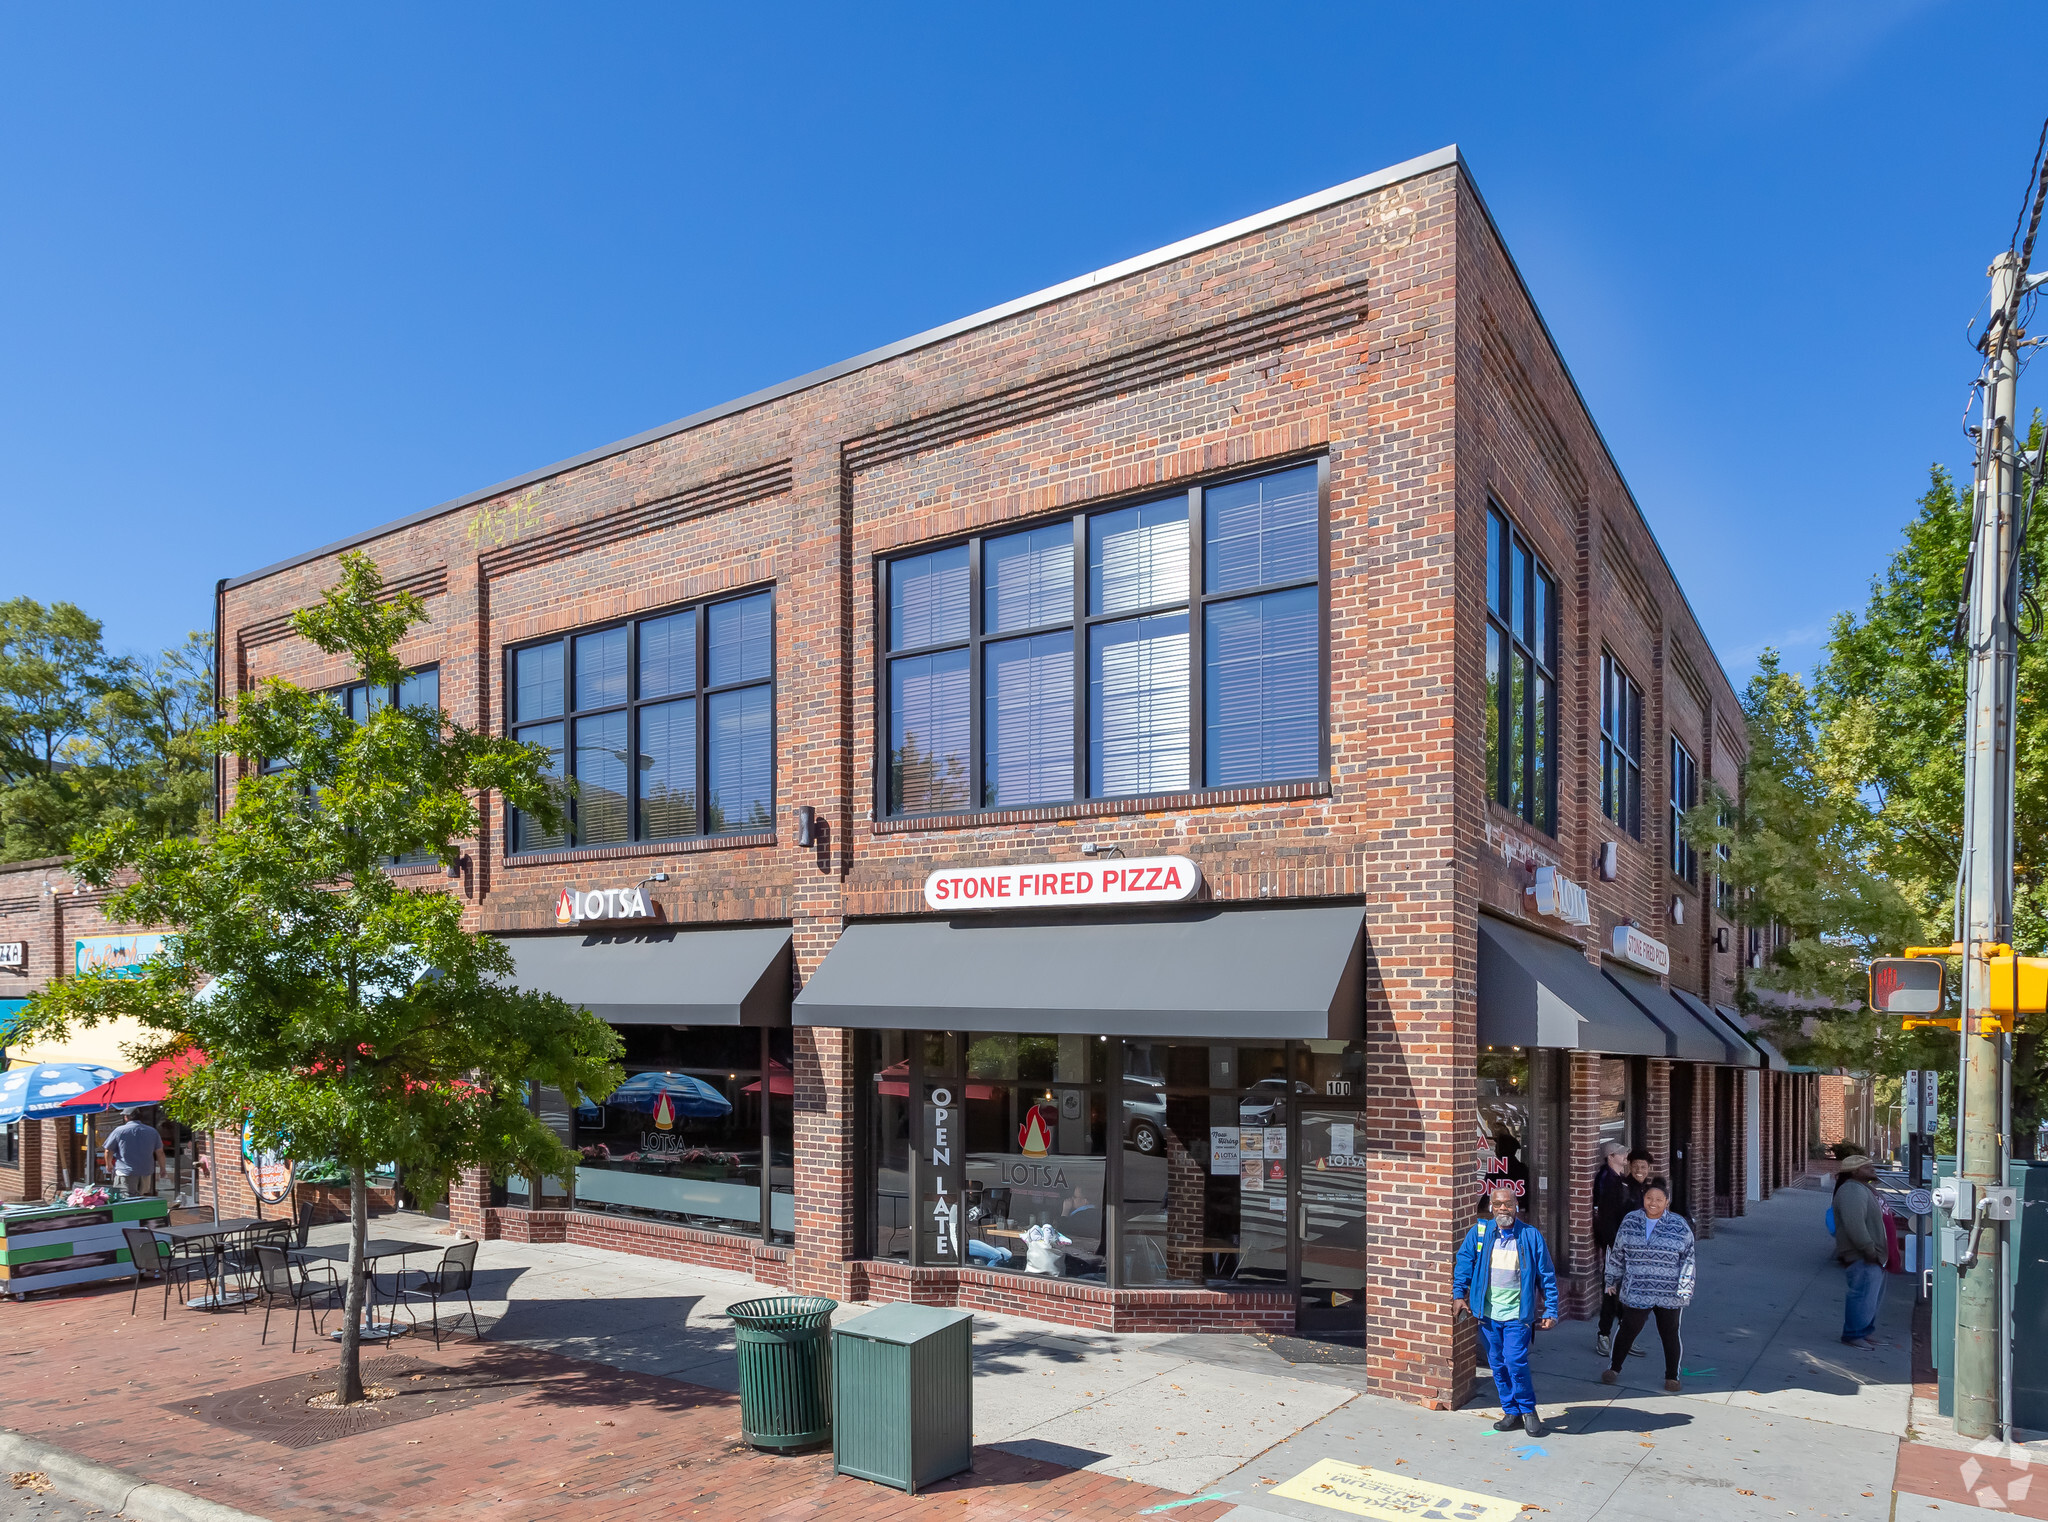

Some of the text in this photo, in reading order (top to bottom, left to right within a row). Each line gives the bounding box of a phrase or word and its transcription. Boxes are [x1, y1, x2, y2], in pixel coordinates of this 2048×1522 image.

[935, 866, 1182, 900] STONE FIRED PIZZA
[574, 887, 647, 920] LOTSA
[1628, 934, 1667, 966] STONE FIRED PIZZA
[1328, 1081, 1350, 1096] 100
[931, 1088, 952, 1166] OPEN
[1211, 1131, 1227, 1139] Now
[640, 1131, 687, 1155] LOTSA
[1218, 1138, 1239, 1147] Hiring
[1000, 1161, 1070, 1190] LOTSA
[1328, 1155, 1365, 1167] LOTSA
[932, 1176, 950, 1254] LATE
[1311, 1485, 1418, 1514] ACKLAND
[1329, 1475, 1432, 1504] MUSEUM
[1382, 1494, 1424, 1509] ART
